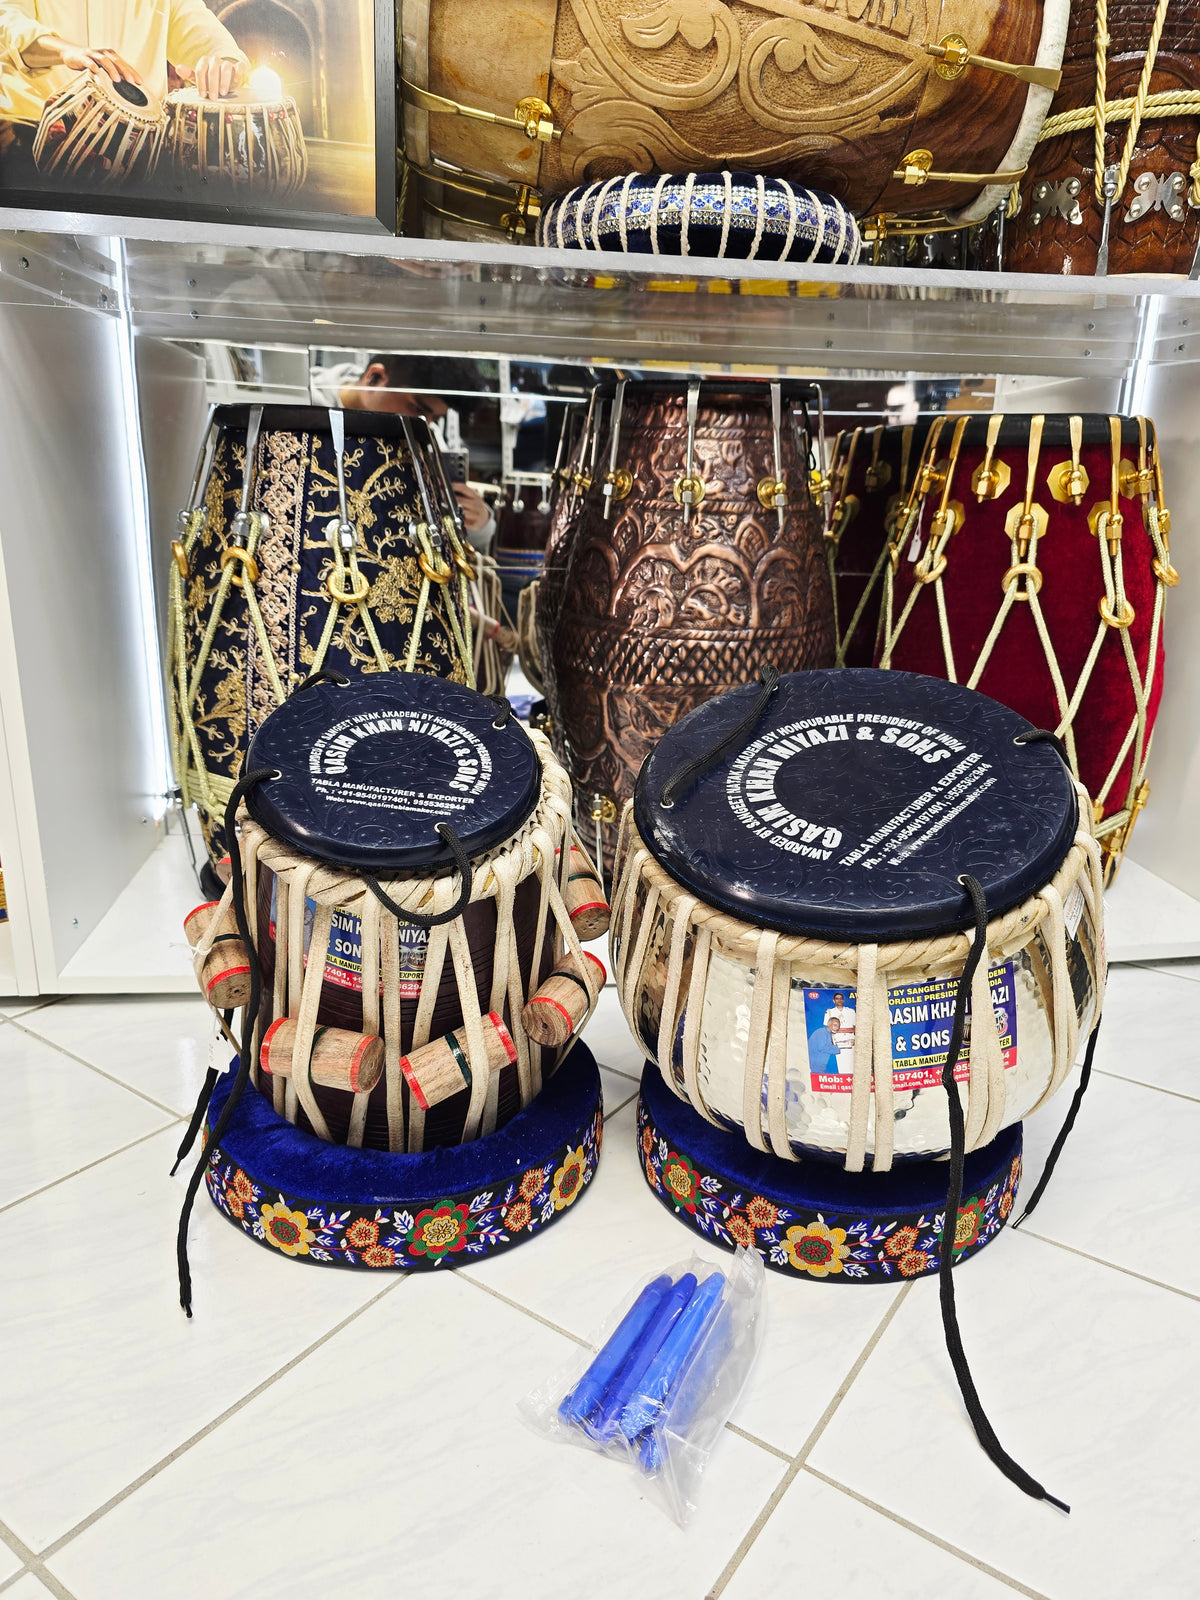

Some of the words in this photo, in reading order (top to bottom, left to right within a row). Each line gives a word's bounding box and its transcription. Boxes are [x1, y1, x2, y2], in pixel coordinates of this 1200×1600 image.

[352, 711, 381, 723] NATAK
[382, 711, 419, 719] AKADEMI
[421, 713, 434, 721] BY
[776, 714, 854, 736] HONOURABLE
[857, 714, 924, 731] PRESIDENT
[321, 719, 353, 740] SANGEET
[349, 719, 403, 739] KHAN
[408, 719, 466, 748] NIYAZI
[433, 716, 481, 745] HONOURABLE
[761, 731, 779, 743] BY
[856, 726, 874, 740] &
[923, 725, 937, 736] OF
[314, 739, 327, 748] BY
[453, 747, 471, 757] &
[766, 724, 849, 760] NIYAZI
[880, 727, 951, 763] SONS
[936, 732, 967, 753] INDIA
[309, 747, 322, 774] AWARDED
[324, 734, 357, 775] QASIM
[473, 742, 492, 772] PRESIDENT
[731, 739, 768, 770] AKADEMI
[449, 758, 479, 792] SONS
[480, 772, 491, 781] OF
[726, 770, 744, 794] NATAK
[745, 757, 783, 802] KHAN
[943, 762, 993, 801] 9555362944
[311, 777, 340, 787] TABLA
[342, 782, 416, 797] MANUFACTURER
[427, 793, 475, 804] EXPORTER
[727, 795, 760, 829] SANGEET
[838, 843, 874, 867] TABLA
[866, 791, 937, 845] MANUFACTURER
[930, 785, 944, 793] &
[937, 752, 983, 787] EXPORTER
[752, 826, 774, 839] BY
[755, 802, 842, 848] QASIM
[769, 835, 832, 861] AWARDED
[334, 938, 363, 959] SON
[893, 988, 905, 997] BY
[907, 983, 945, 996] SANGEET
[924, 989, 958, 1002] PRESIDE
[895, 1036, 907, 1052] &
[911, 1029, 950, 1051] SONS
[895, 1058, 918, 1068] TABLA
